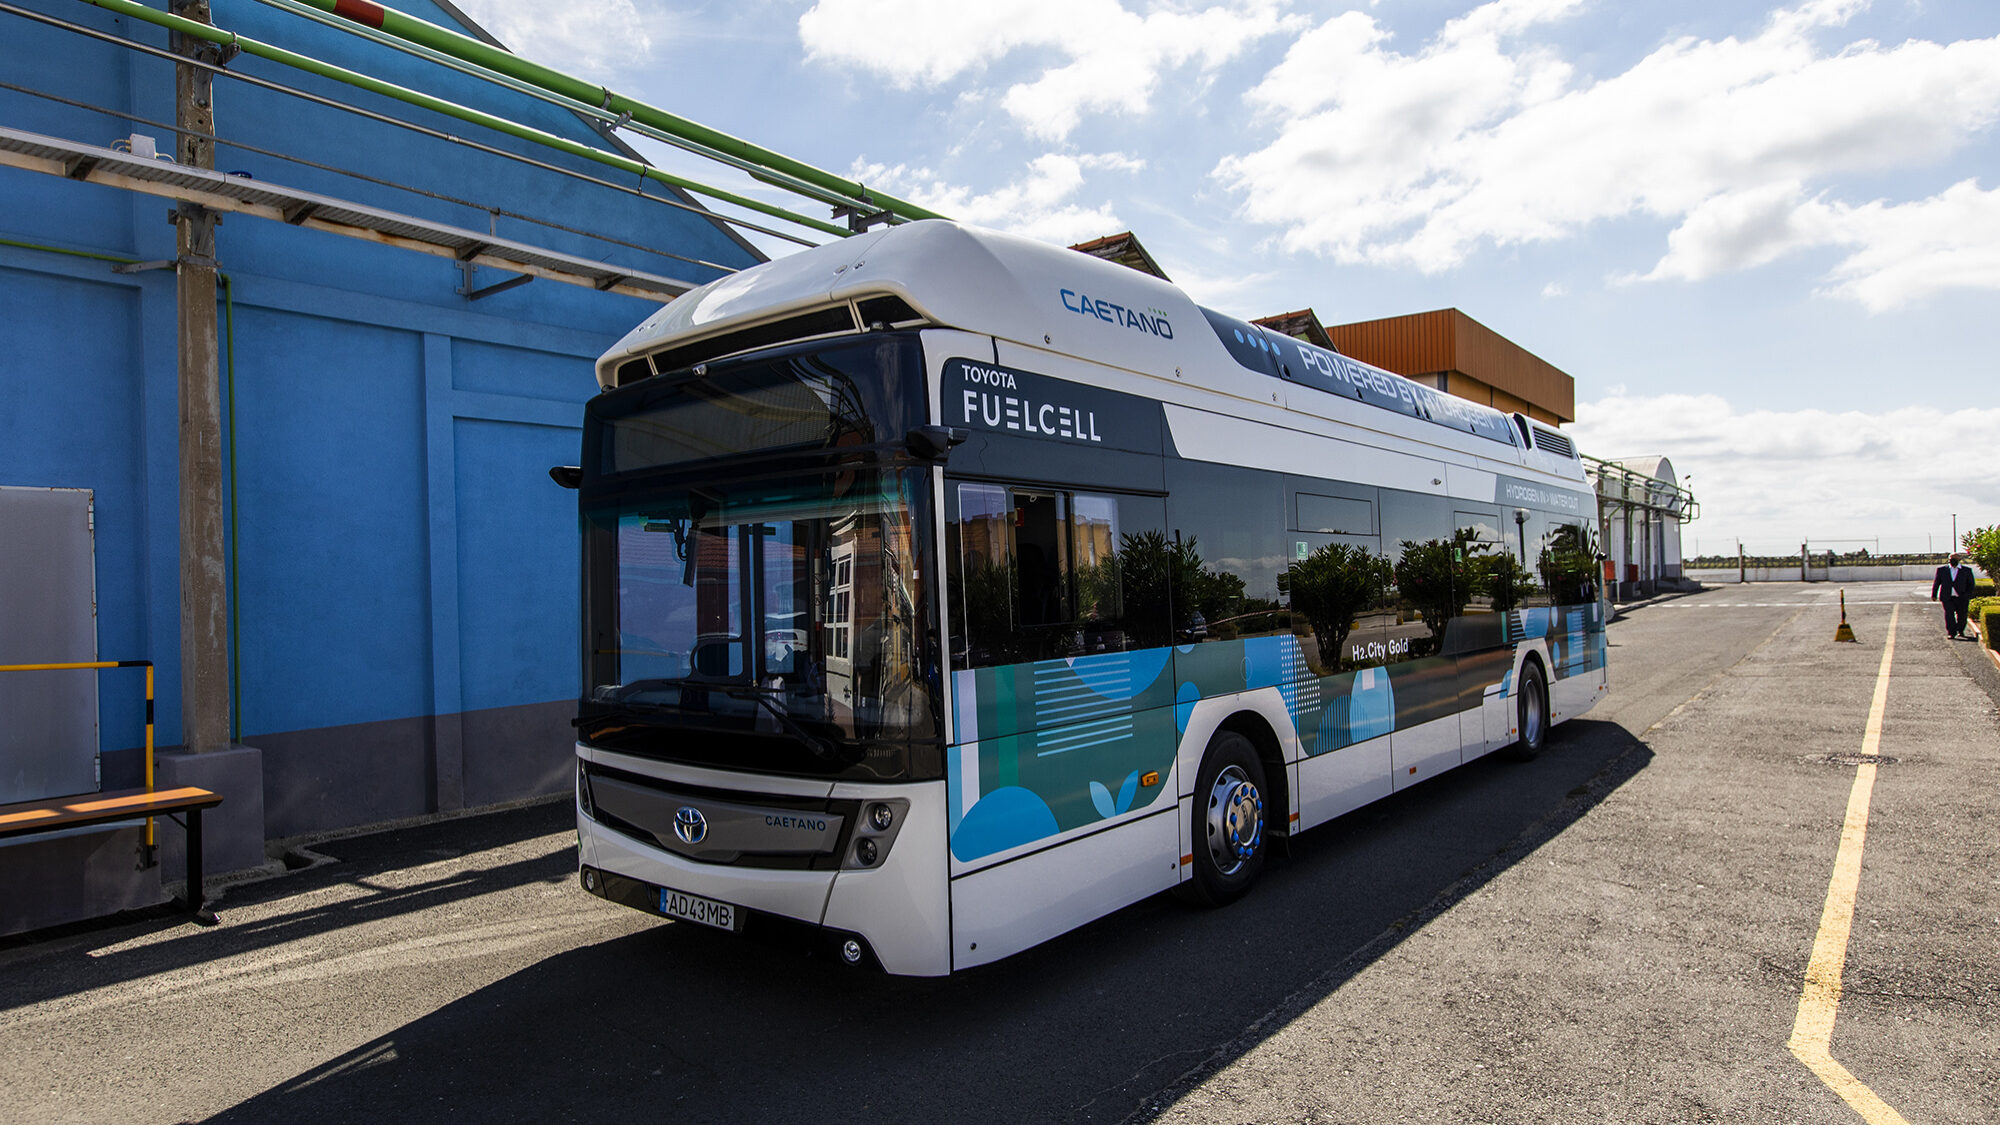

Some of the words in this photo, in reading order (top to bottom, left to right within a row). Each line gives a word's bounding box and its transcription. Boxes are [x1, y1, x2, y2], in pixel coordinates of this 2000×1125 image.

[1060, 288, 1173, 339] CAETANO
[961, 364, 1017, 390] TOYOTA
[1297, 345, 1397, 398] POWERED
[1396, 380, 1420, 407] BY
[963, 389, 1101, 442] FUELCELL
[1505, 484, 1539, 502] HYDROGEN
[1388, 637, 1409, 655] Gold
[765, 815, 826, 832] CAETANO
[668, 893, 729, 927] AD43MB
